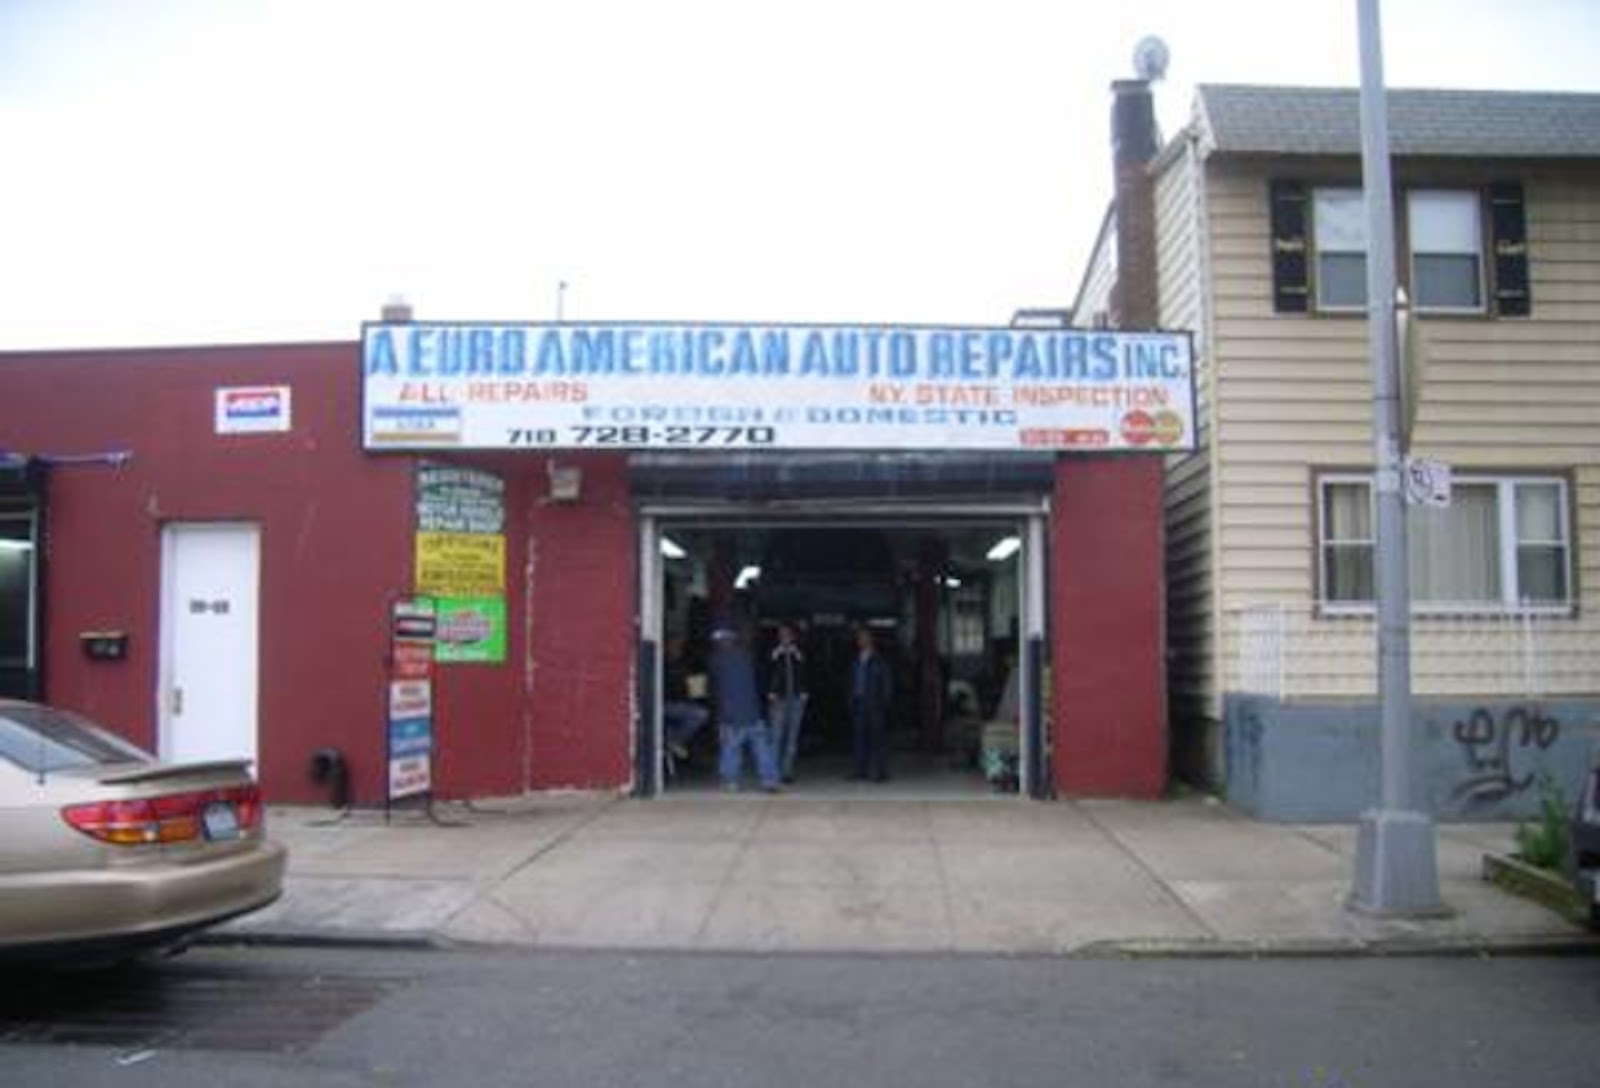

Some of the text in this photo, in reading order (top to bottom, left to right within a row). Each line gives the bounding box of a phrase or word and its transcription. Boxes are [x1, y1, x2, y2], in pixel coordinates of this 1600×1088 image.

[369, 329, 399, 374] A
[408, 329, 526, 375] EURO
[533, 329, 790, 375] AMERICAN
[800, 330, 918, 375] AUTO
[928, 331, 1118, 379] REPAIRS
[399, 381, 589, 403] ALL REPAIRS
[1012, 385, 1169, 406] INSPECTION
[805, 407, 1017, 425] DOMESTIC
[569, 425, 776, 443] 728-2770
